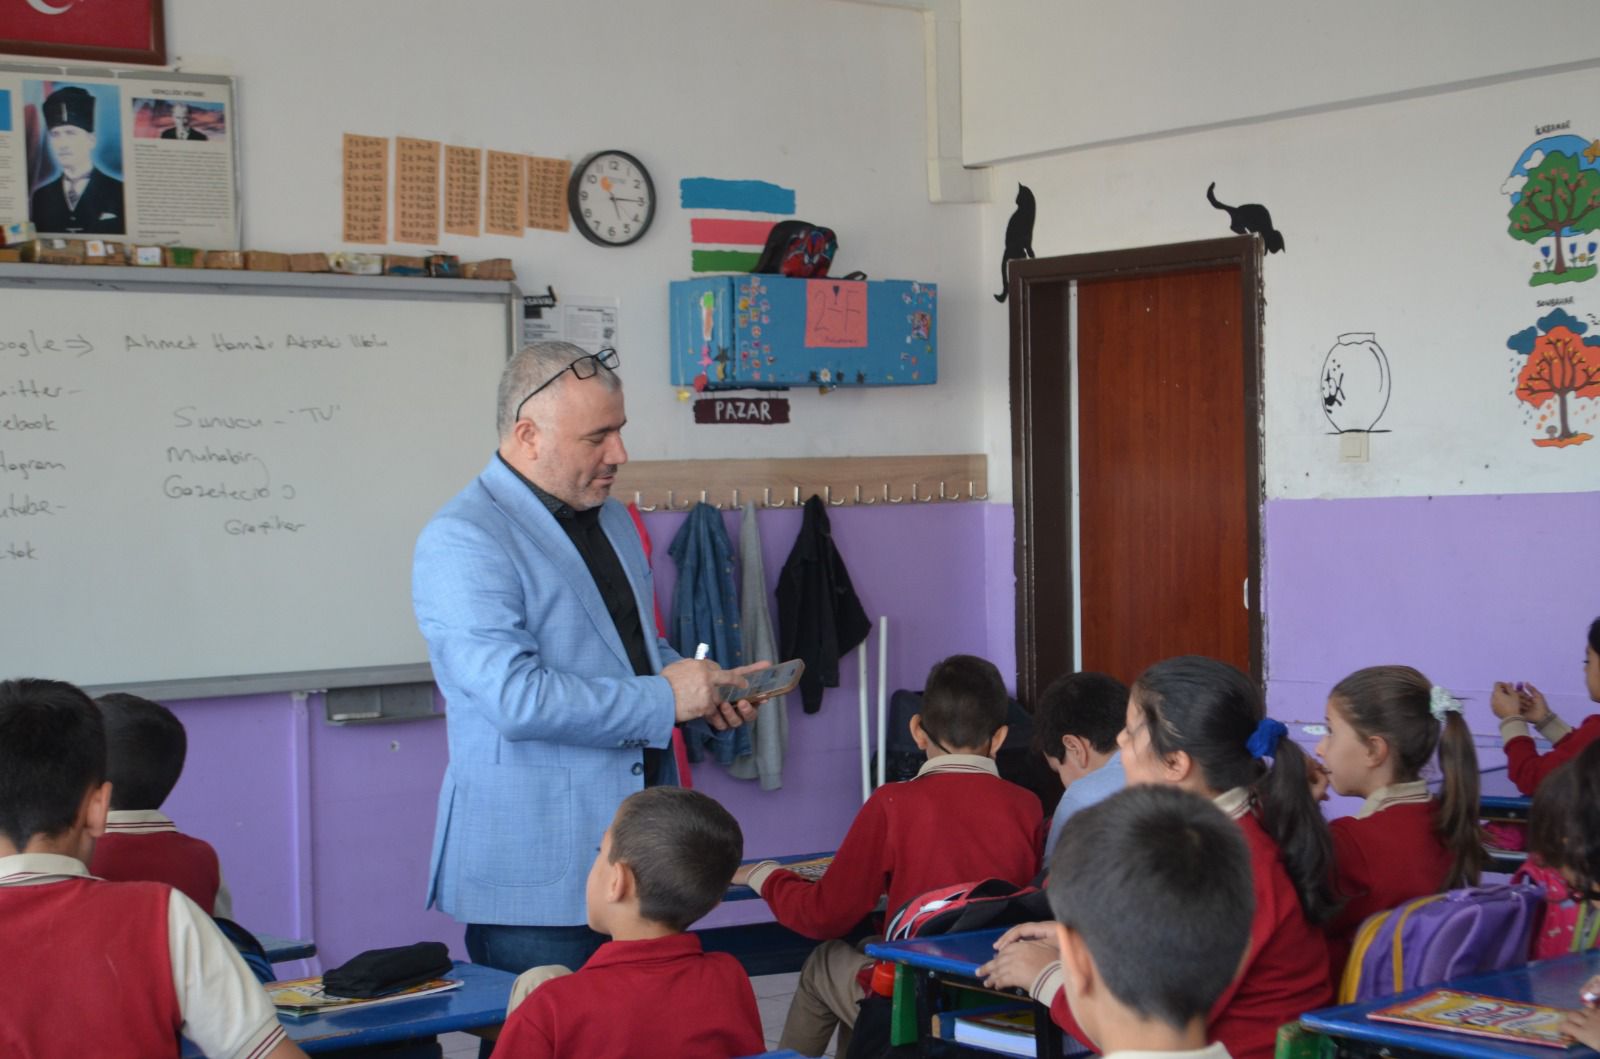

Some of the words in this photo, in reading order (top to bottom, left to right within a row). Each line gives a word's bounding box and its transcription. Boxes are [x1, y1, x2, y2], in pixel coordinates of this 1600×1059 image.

[607, 225, 617, 237] 6
[623, 222, 631, 235] 5
[715, 400, 772, 421] PAZAR
[0, 413, 60, 431] ebook
